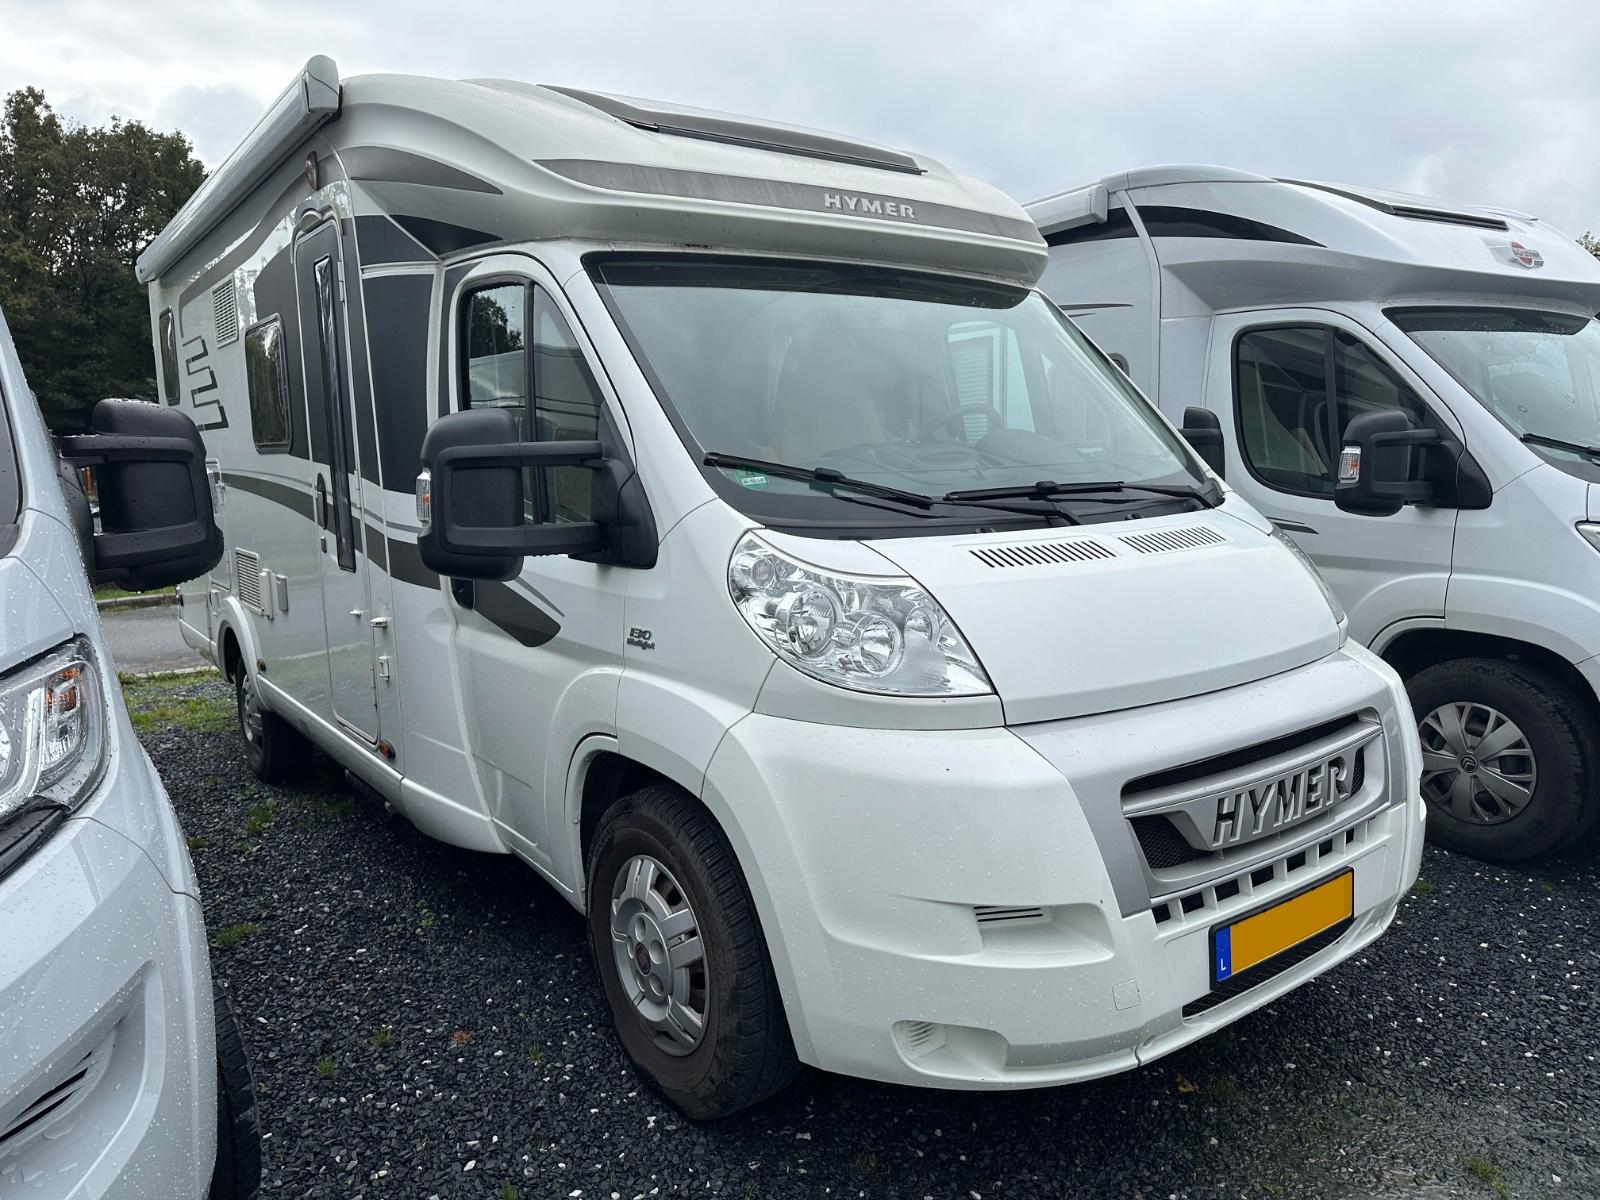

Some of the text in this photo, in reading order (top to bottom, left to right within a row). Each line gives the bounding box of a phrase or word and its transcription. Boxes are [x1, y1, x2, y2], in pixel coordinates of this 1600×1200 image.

[824, 192, 917, 219] HYMER
[1212, 756, 1350, 848] HYMER
[1220, 958, 1227, 972] L
